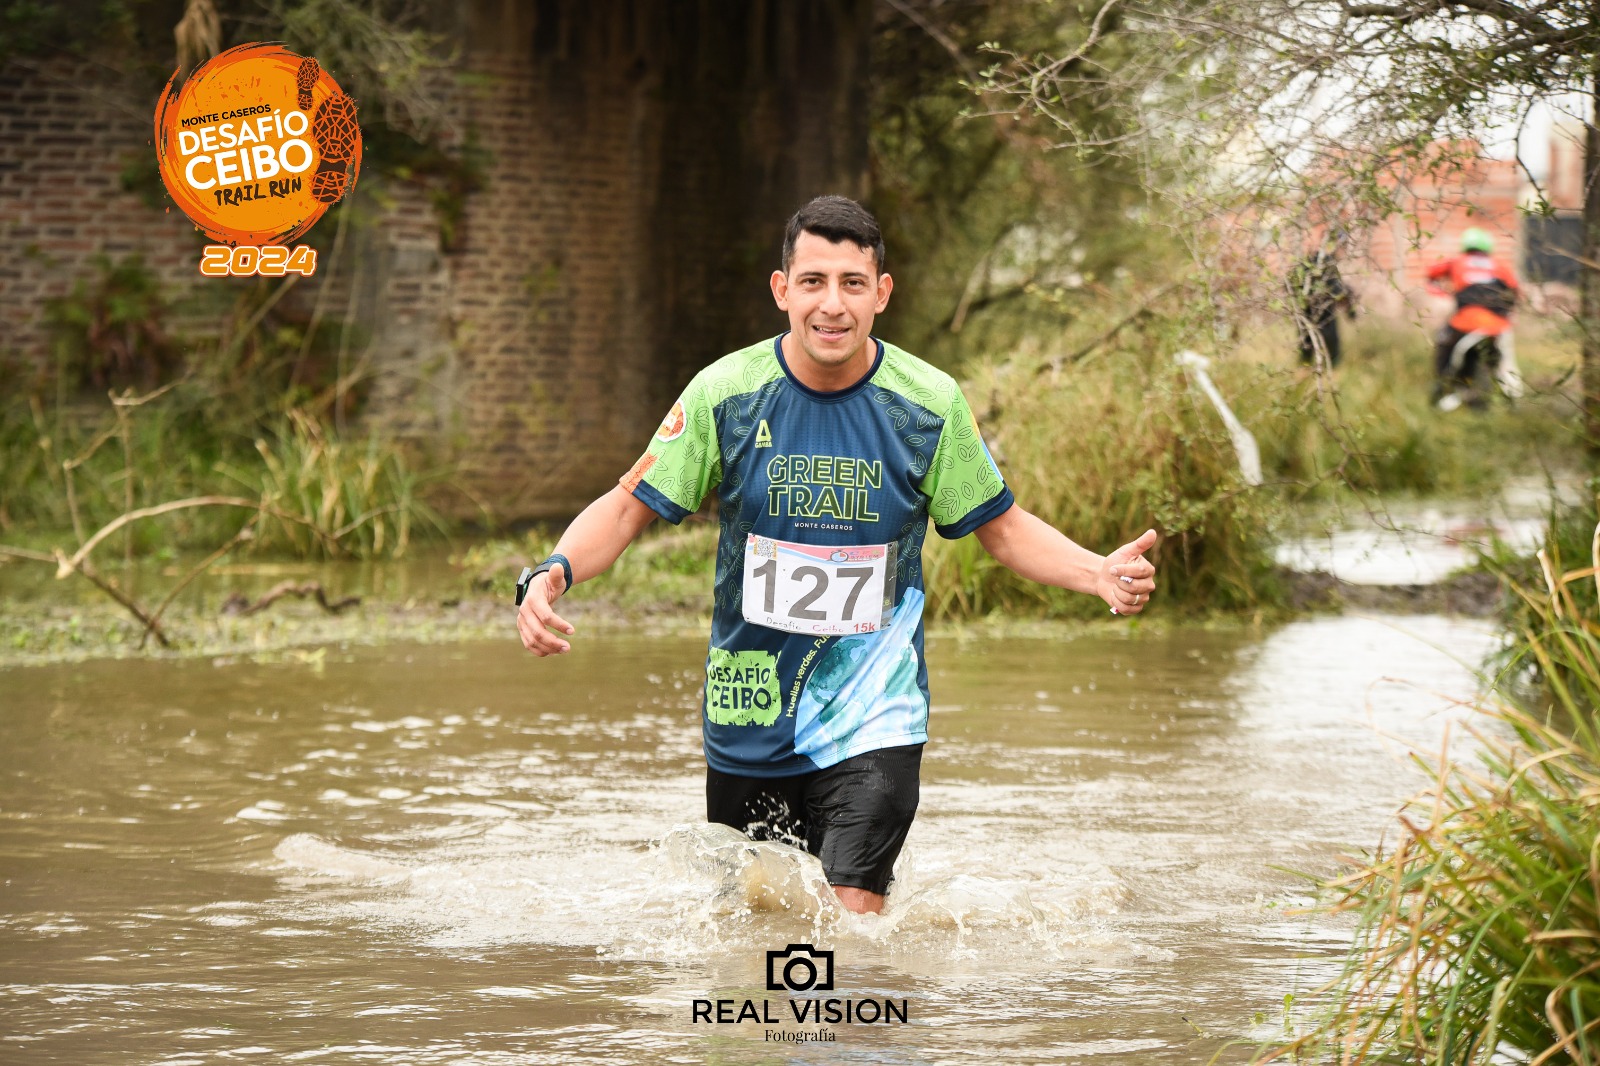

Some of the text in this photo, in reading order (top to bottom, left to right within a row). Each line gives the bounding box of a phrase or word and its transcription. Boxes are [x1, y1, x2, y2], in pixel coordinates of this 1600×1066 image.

[766, 454, 883, 489] GREEN
[767, 484, 880, 522] TRAIL
[820, 523, 853, 531] CASEROS
[752, 558, 874, 622] 127
[853, 621, 876, 633] 15k
[709, 662, 771, 685] DESAFÍO
[785, 680, 801, 718] Huellas
[795, 649, 818, 680] verdes.
[711, 684, 772, 711] CEIBO
